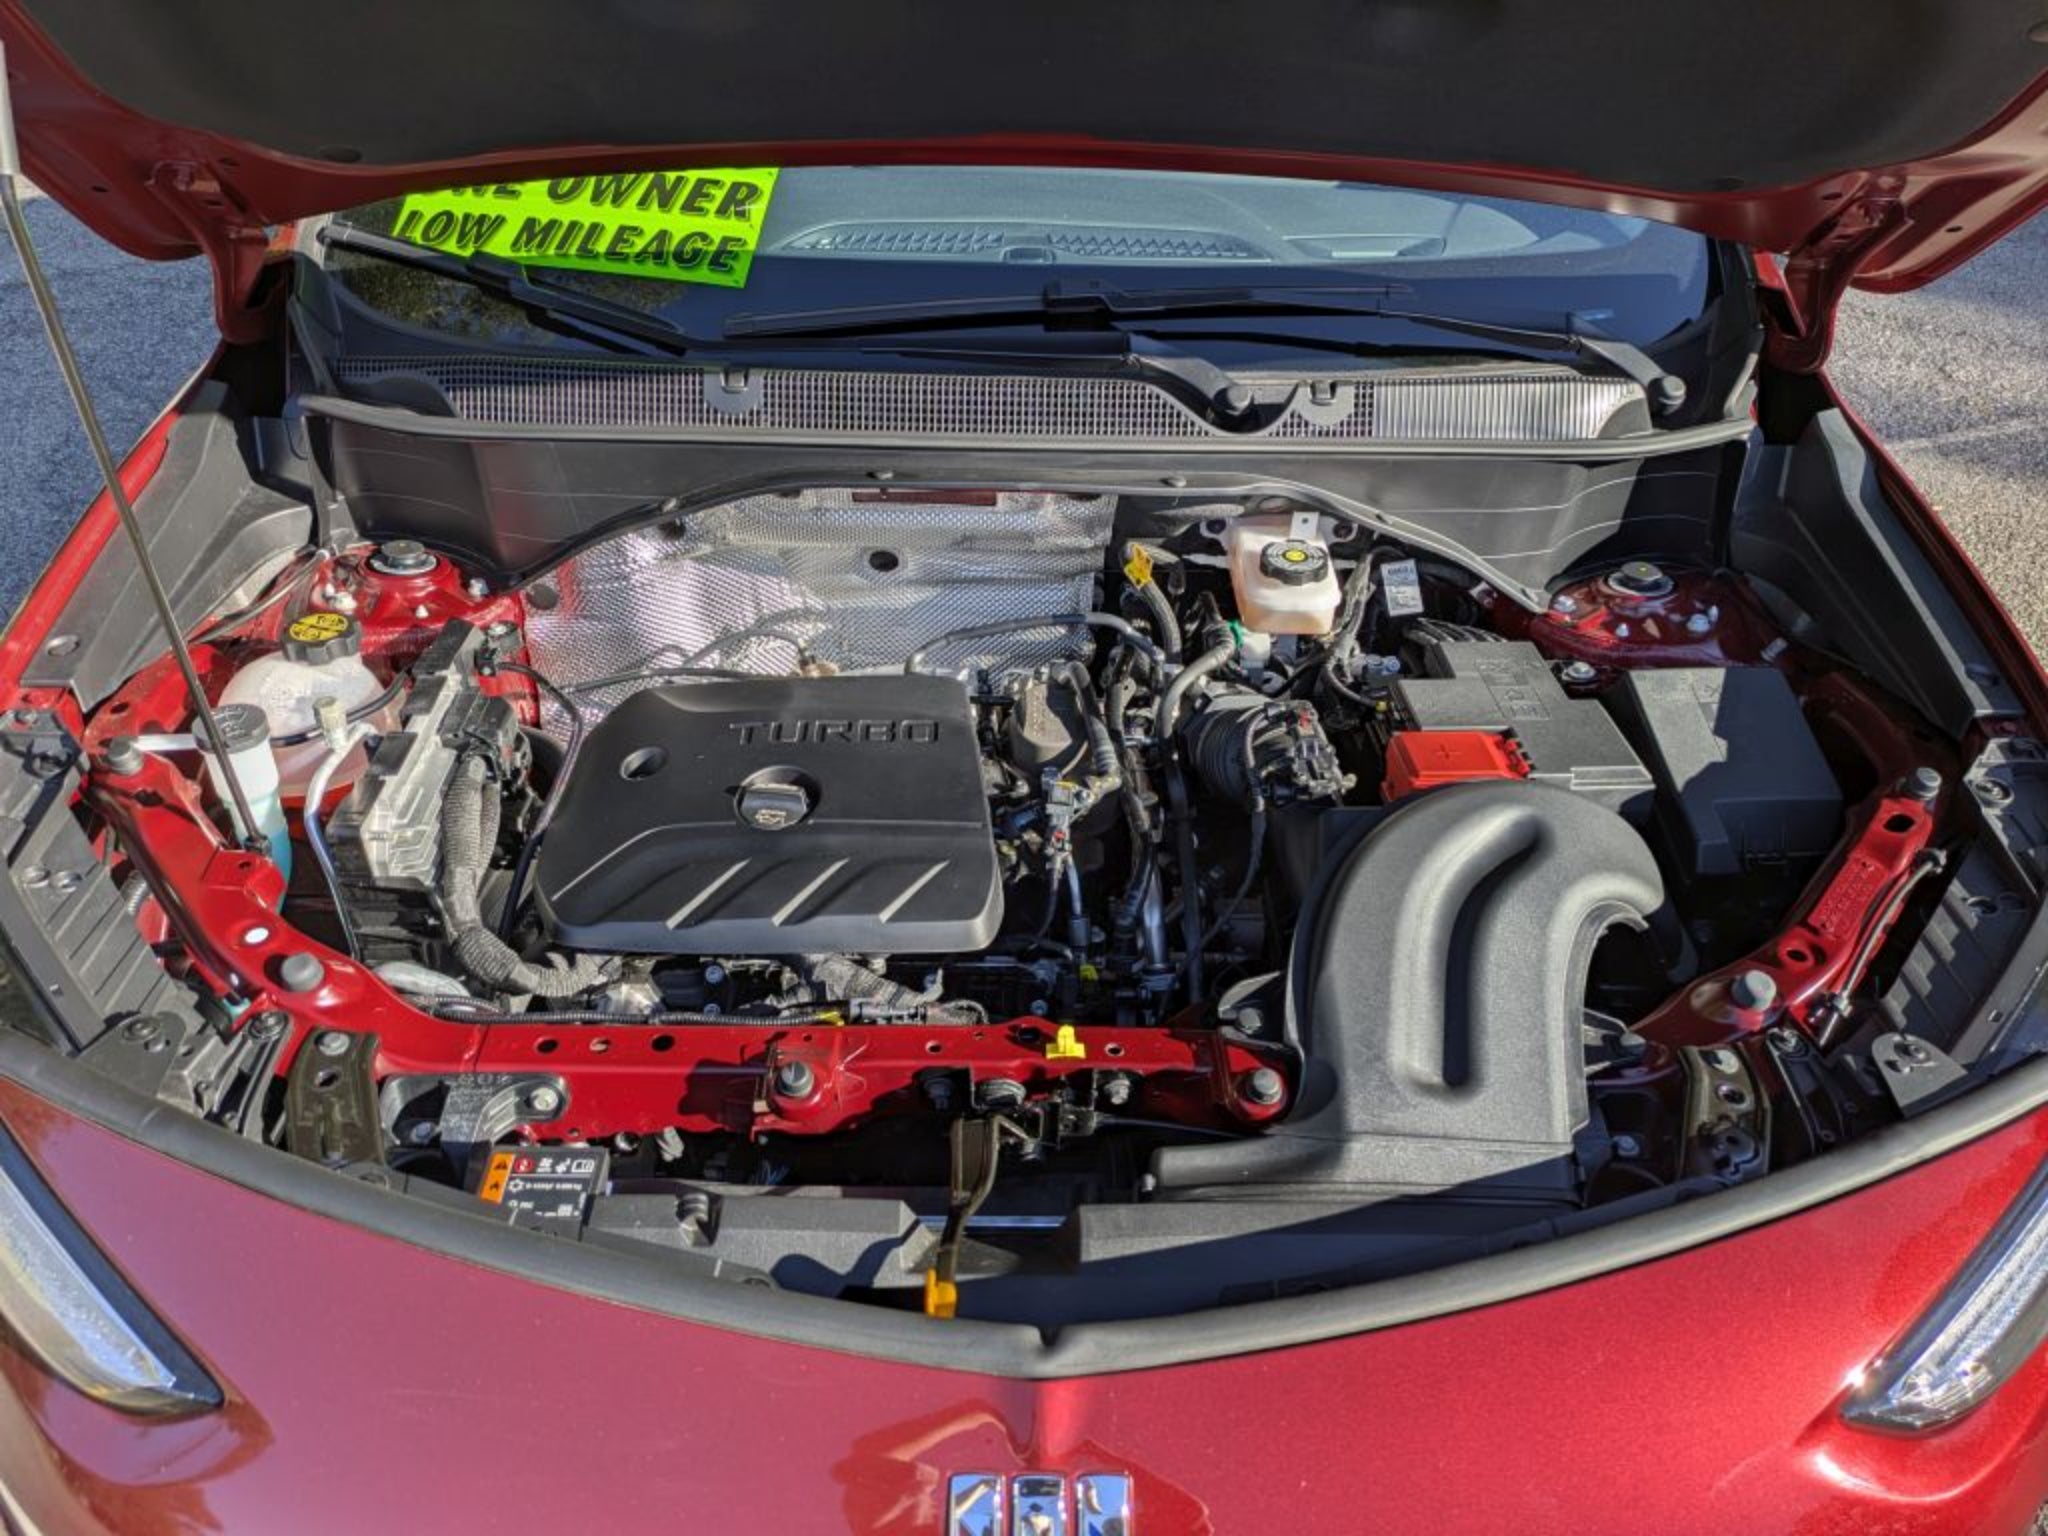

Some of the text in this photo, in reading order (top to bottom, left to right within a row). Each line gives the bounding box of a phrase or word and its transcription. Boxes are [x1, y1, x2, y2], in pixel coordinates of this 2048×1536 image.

[547, 173, 763, 221] OWNER
[398, 209, 747, 272] LOW MILEAGE
[729, 719, 939, 744] TURBO
